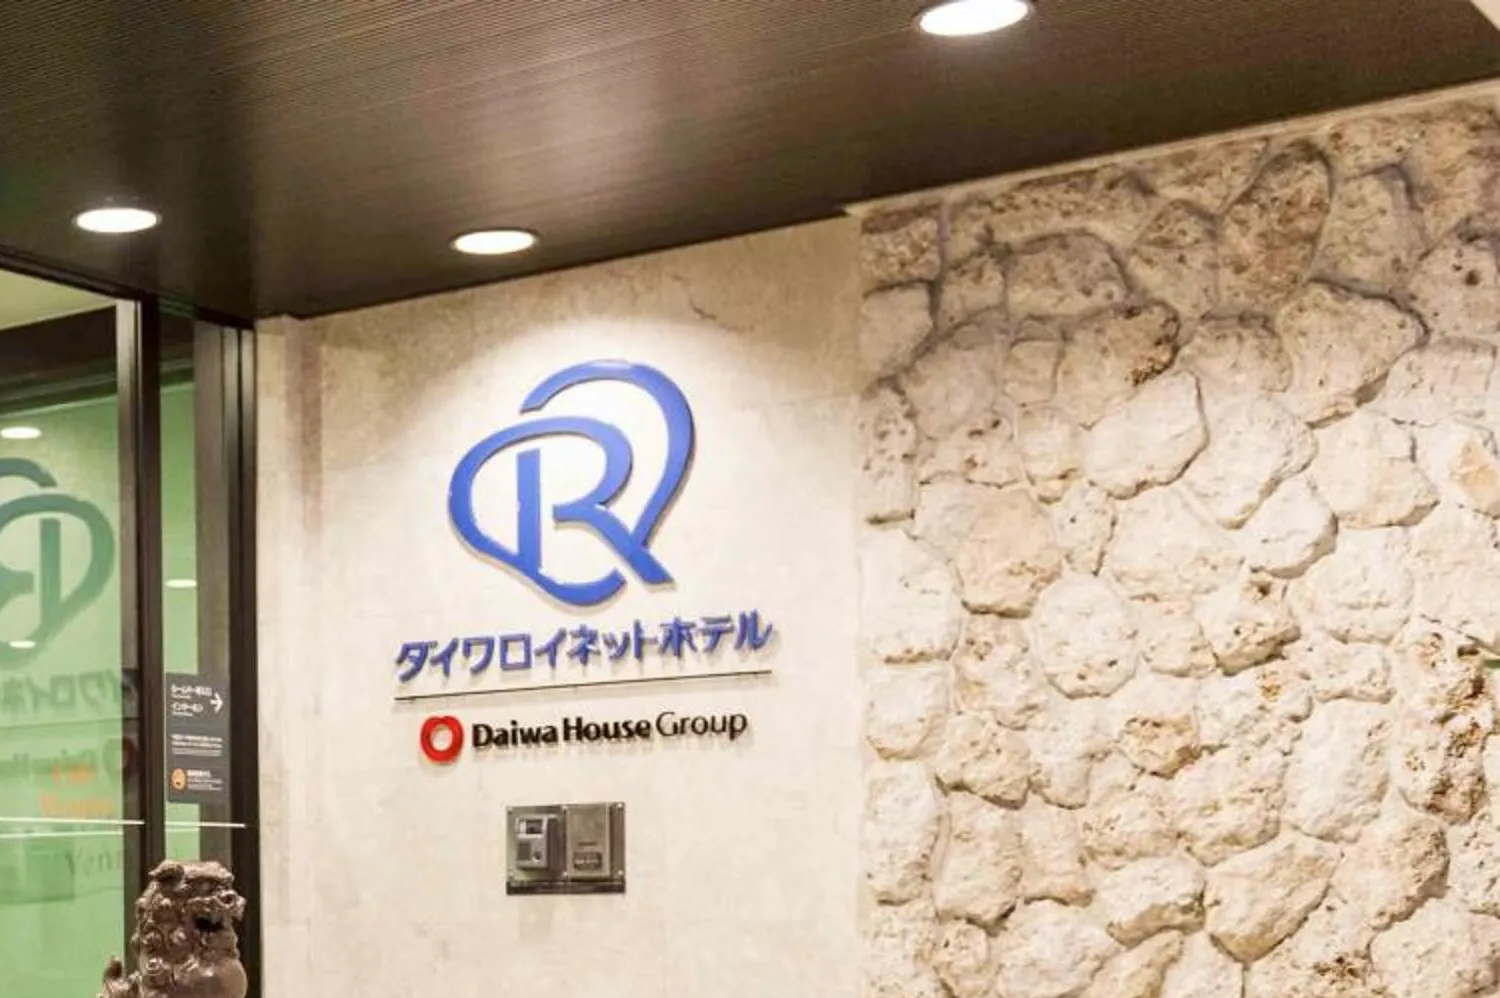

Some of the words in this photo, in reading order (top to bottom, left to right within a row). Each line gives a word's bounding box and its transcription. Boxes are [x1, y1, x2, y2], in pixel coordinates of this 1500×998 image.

[395, 610, 772, 682] ダイワロイネットホテル
[471, 720, 558, 748] Daiwa
[562, 716, 651, 743] House
[655, 711, 747, 740] Group
